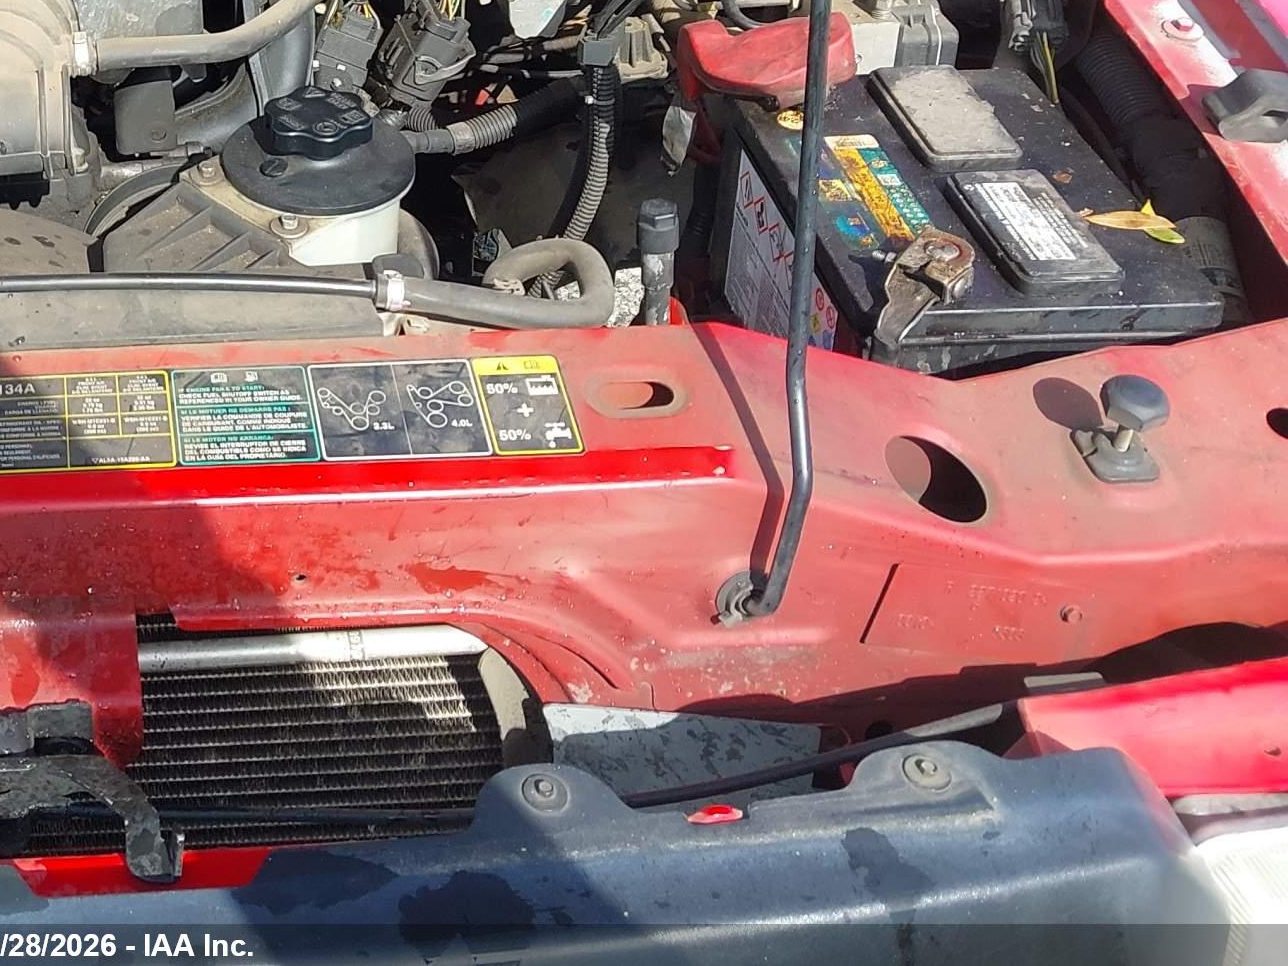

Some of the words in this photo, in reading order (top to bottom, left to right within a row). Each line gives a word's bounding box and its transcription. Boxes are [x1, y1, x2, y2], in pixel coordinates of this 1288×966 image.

[486, 383, 518, 394] 50%
[451, 419, 473, 428] 4.0L
[499, 429, 532, 441] 50%
